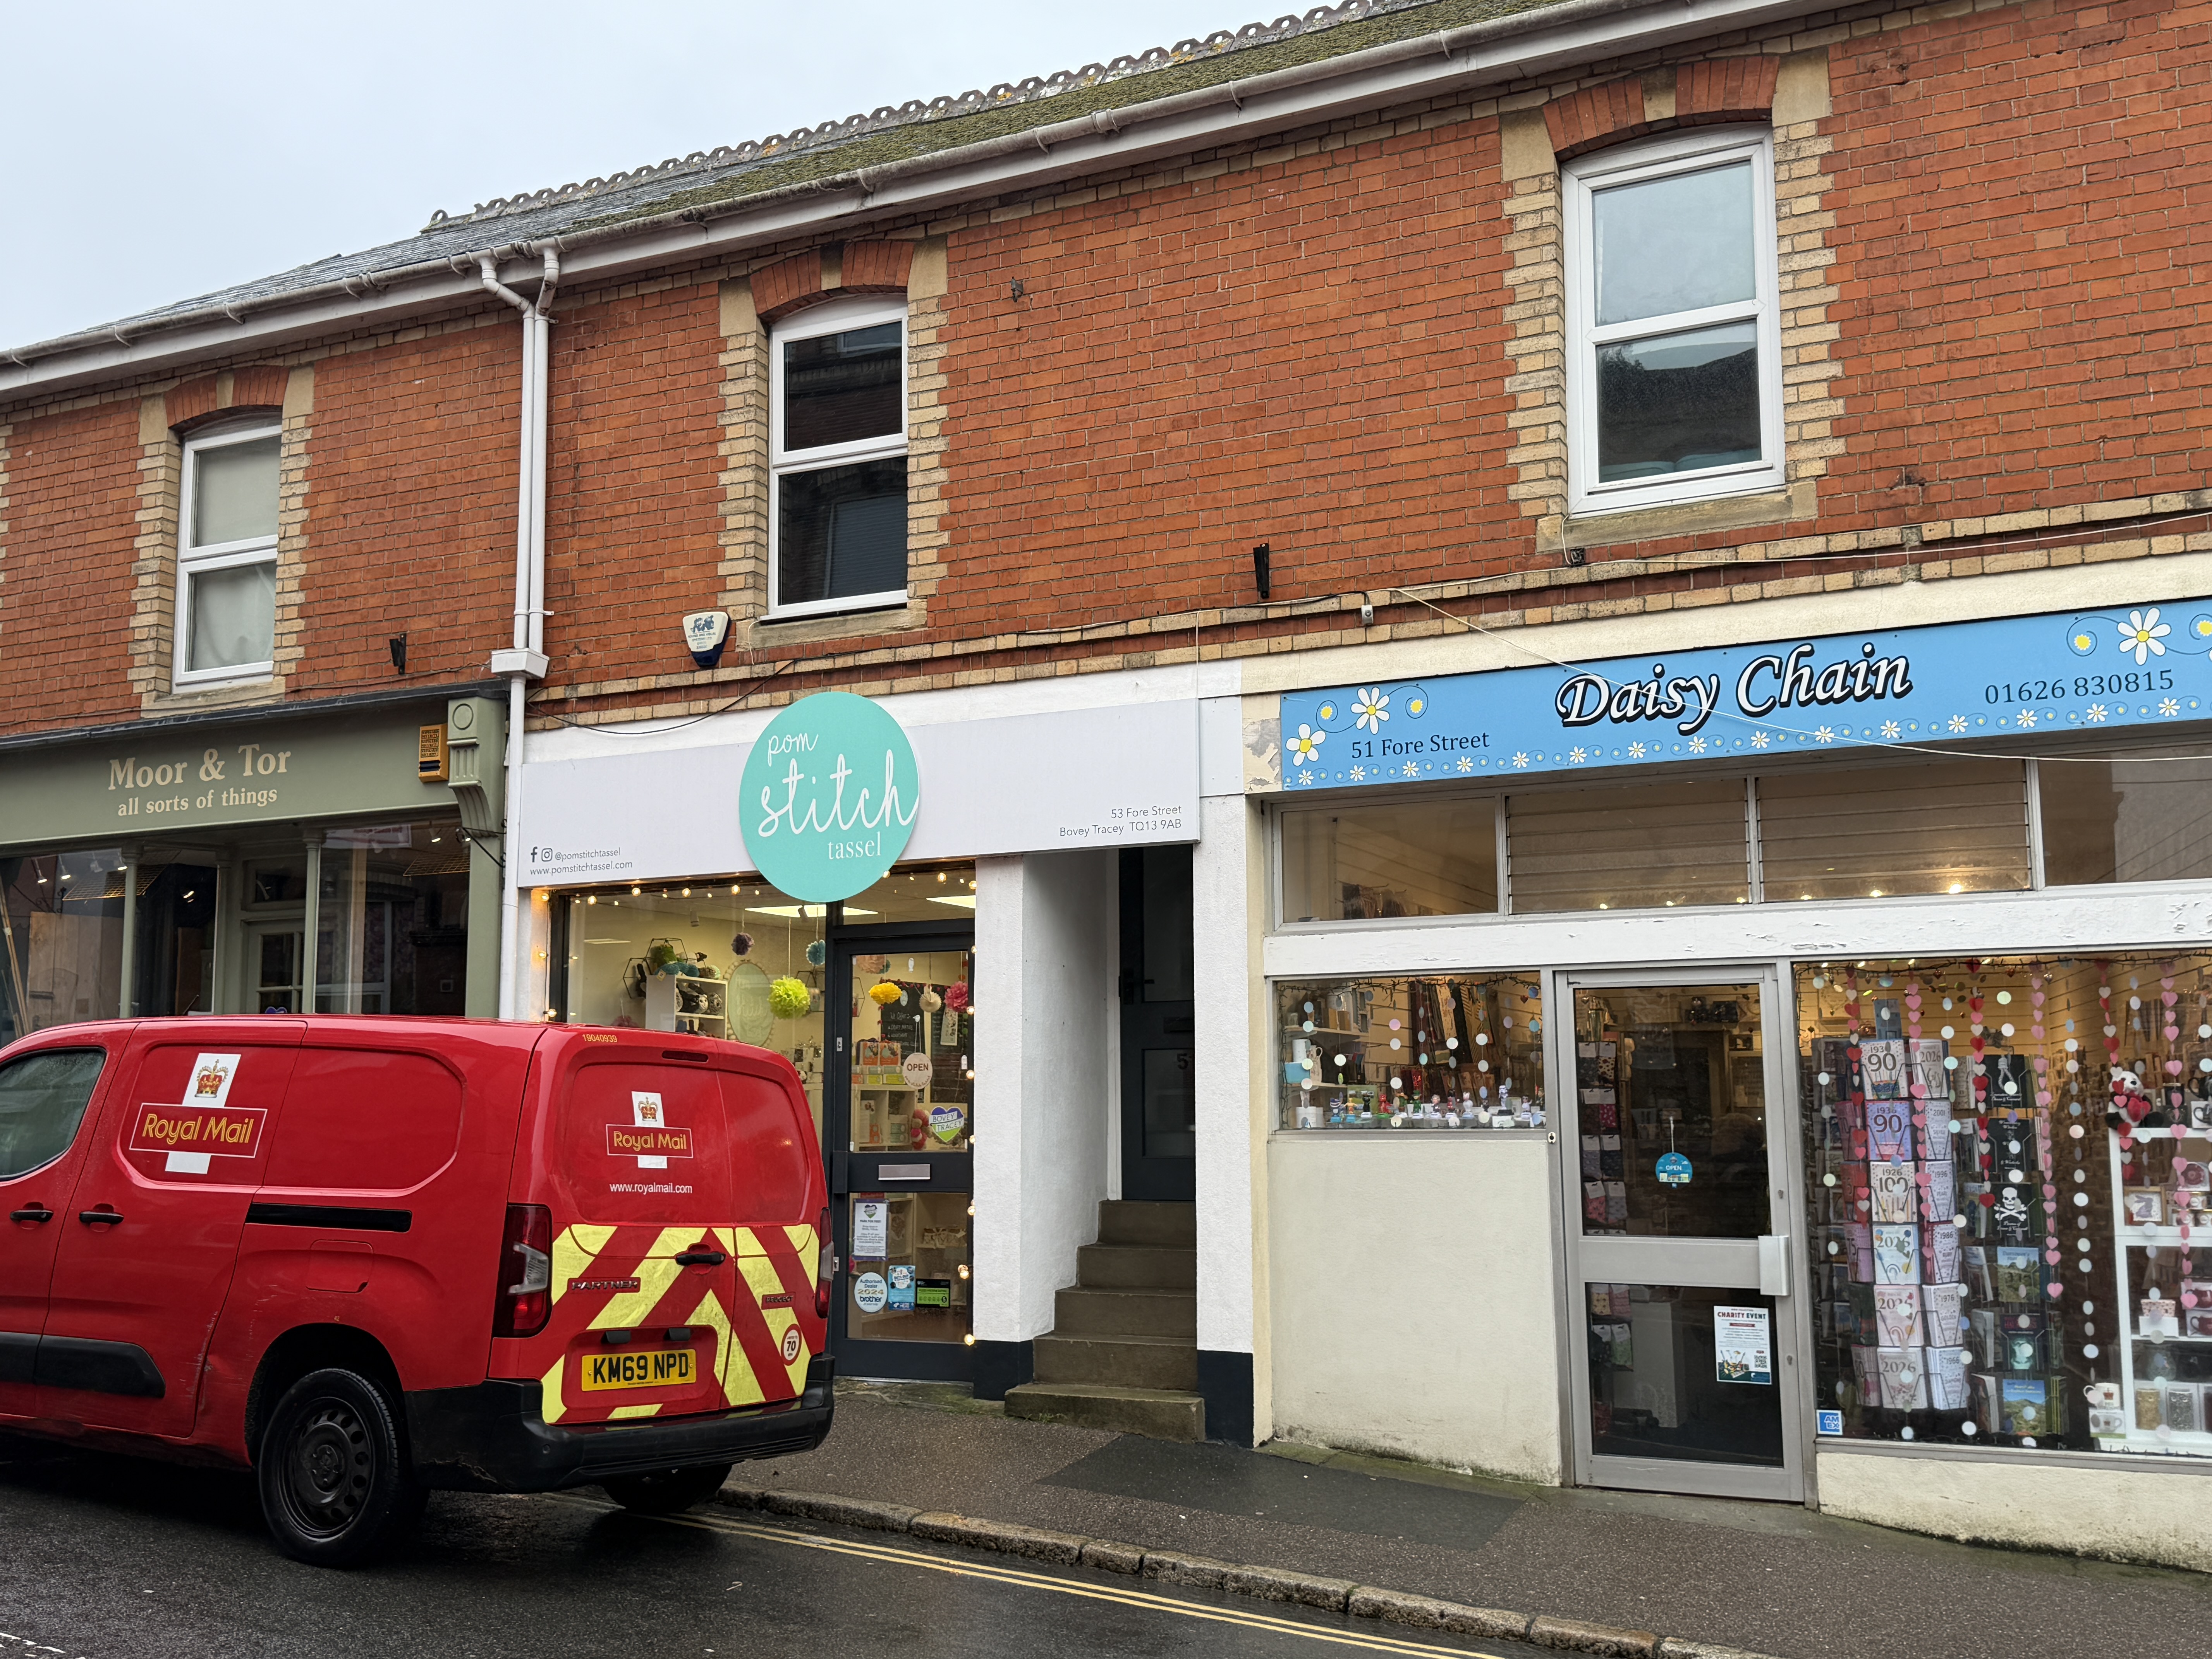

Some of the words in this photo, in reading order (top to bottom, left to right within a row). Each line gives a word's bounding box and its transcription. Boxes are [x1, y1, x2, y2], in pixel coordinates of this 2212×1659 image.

[1555, 663, 1720, 736] Daisy
[1736, 642, 1913, 717] Chain
[1985, 679, 2066, 704] 01626
[2074, 670, 2174, 698] 830815
[767, 733, 819, 767] pom
[1351, 740, 1372, 759] 51
[1381, 736, 1424, 756] Fore
[1430, 731, 1490, 752] Street
[109, 757, 187, 791] Moor
[199, 749, 225, 781] &
[237, 744, 292, 777] Tor
[118, 797, 139, 817] all
[146, 793, 189, 814] sorts
[196, 789, 213, 809] of
[222, 787, 278, 808] things
[758, 749, 919, 838] stitch
[1111, 809, 1123, 819] 53
[1127, 807, 1149, 818] Fore
[1152, 805, 1182, 816] Street
[1060, 826, 1090, 837] Bovey
[1092, 824, 1124, 835] Tracey
[1129, 820, 1158, 832] TQ13
[1160, 819, 1182, 830] 9AB
[555, 847, 621, 861] @pomstitchtassel
[828, 831, 882, 860] tassel
[529, 859, 633, 876] www.pomstitchtassel.com
[582, 1034, 618, 1043] 19040939
[1868, 1053, 1896, 1072] 90
[1920, 1051, 1941, 1063] 2026
[907, 1063, 929, 1072] OPEN
[933, 1113, 955, 1122] BOVEY
[937, 1119, 962, 1132] TRACEY
[1874, 1114, 1903, 1133] 90
[142, 1113, 203, 1145] Royal
[203, 1116, 254, 1143] Mail
[613, 1131, 655, 1152] Royal
[657, 1133, 687, 1151] Mail
[610, 1182, 693, 1195] www.royalmail.com
[1879, 1176, 1908, 1193] 100
[1940, 1231, 1953, 1239] 1986
[571, 1280, 638, 1290] PARTNER
[765, 1294, 794, 1304] PEUGEOT
[1941, 1294, 1954, 1302] 1976
[786, 1340, 797, 1352] 70
[593, 1355, 649, 1384] KM69
[653, 1352, 689, 1379] NPD
[1881, 1360, 1916, 1373] 2026
